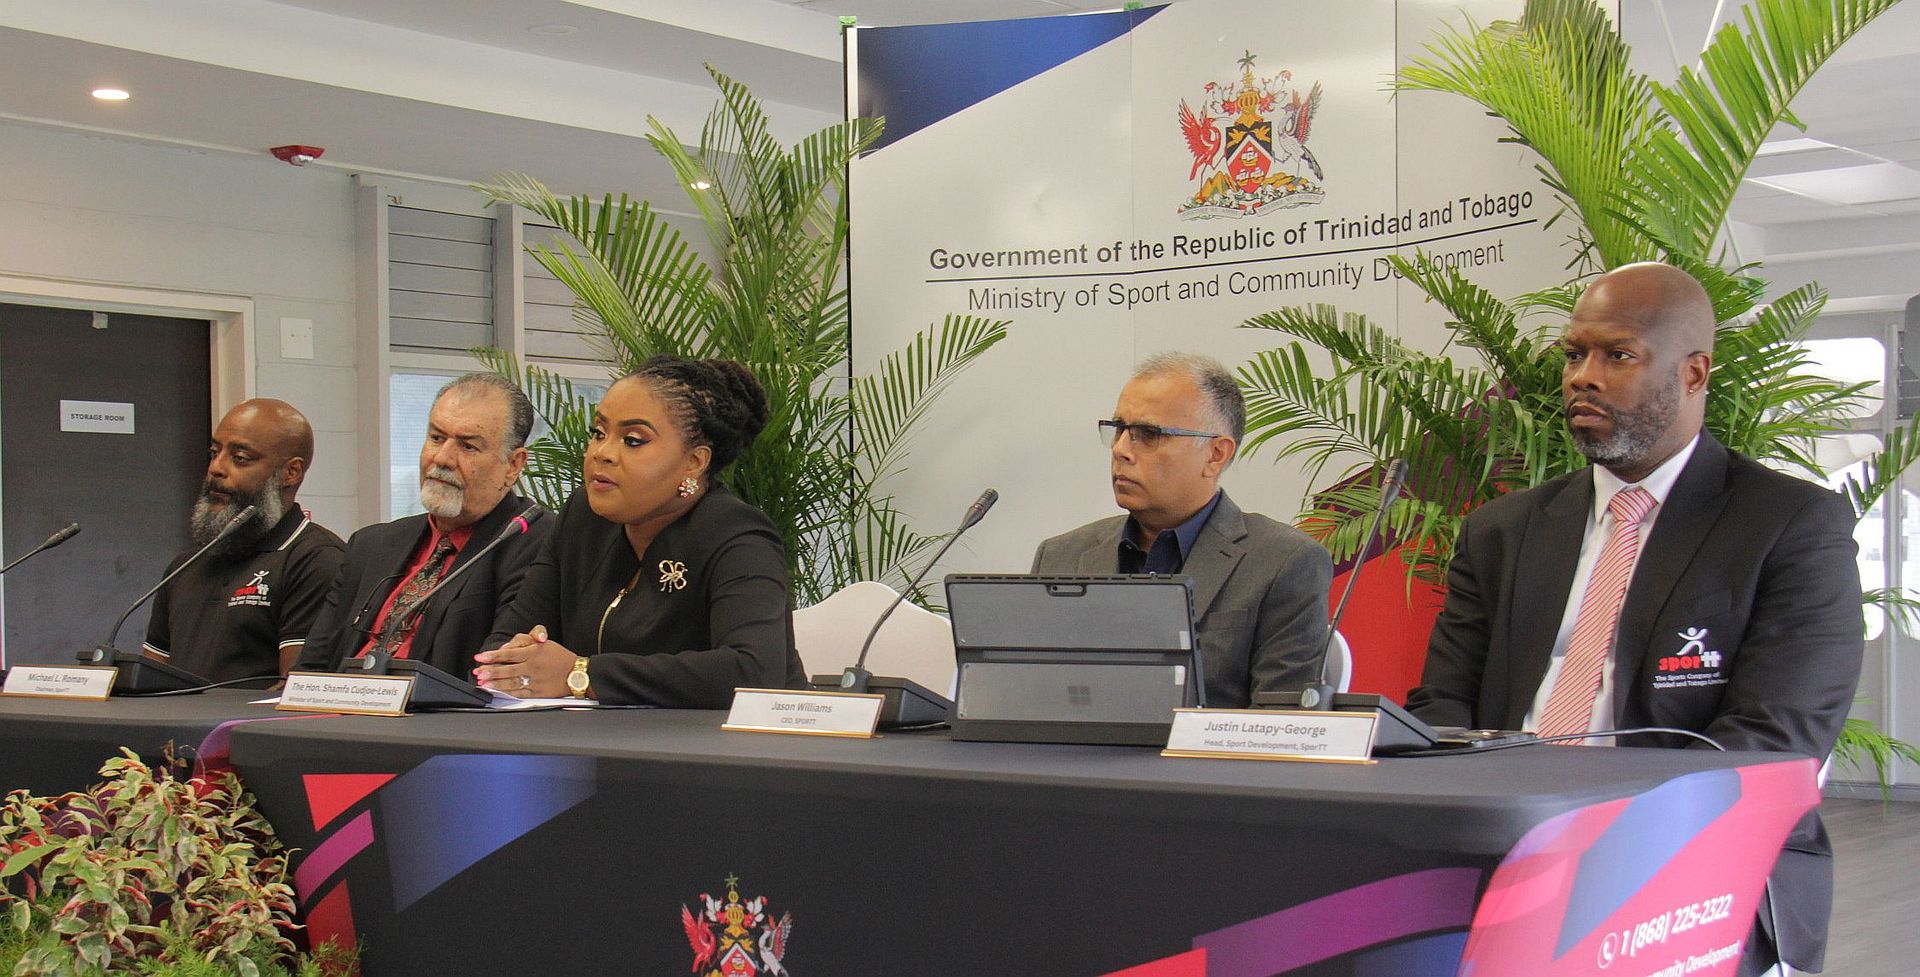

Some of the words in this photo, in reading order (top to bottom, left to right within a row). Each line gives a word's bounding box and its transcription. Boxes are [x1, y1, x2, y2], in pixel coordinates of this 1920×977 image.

[929, 243, 1088, 270] Government
[1097, 241, 1122, 262] of
[1130, 240, 1164, 261] the
[1173, 226, 1275, 259] Republic
[1283, 222, 1307, 245] of
[1314, 208, 1412, 242] Trinidad
[1418, 201, 1453, 229] and
[1458, 190, 1533, 219] Tobago
[968, 286, 1066, 313] Ministry
[1075, 283, 1100, 306] of
[1107, 279, 1170, 310] Sport
[1178, 273, 1220, 300] and
[1228, 261, 1364, 295] Community
[70, 413, 103, 421] STORAGE
[27, 673, 54, 682] Michael
[62, 674, 89, 685] Romany
[291, 682, 305, 691] The
[305, 683, 320, 692] Hon.
[323, 683, 350, 694] Shamfa
[350, 685, 399, 697] Cudjoe-Lewis
[771, 702, 796, 712] Jason
[797, 703, 833, 713] Williams
[1204, 721, 1239, 732] Justin
[1241, 722, 1327, 738] Latapy-George
[1204, 739, 1224, 747] Head,
[1226, 739, 1246, 749] Sport
[1247, 740, 1298, 751] Development,
[1300, 742, 1327, 751] SporTT
[1620, 930, 1631, 956] 1
[1629, 911, 1672, 958] (868)
[1671, 893, 1733, 935] 225-2322
[1685, 939, 1741, 974] Development
